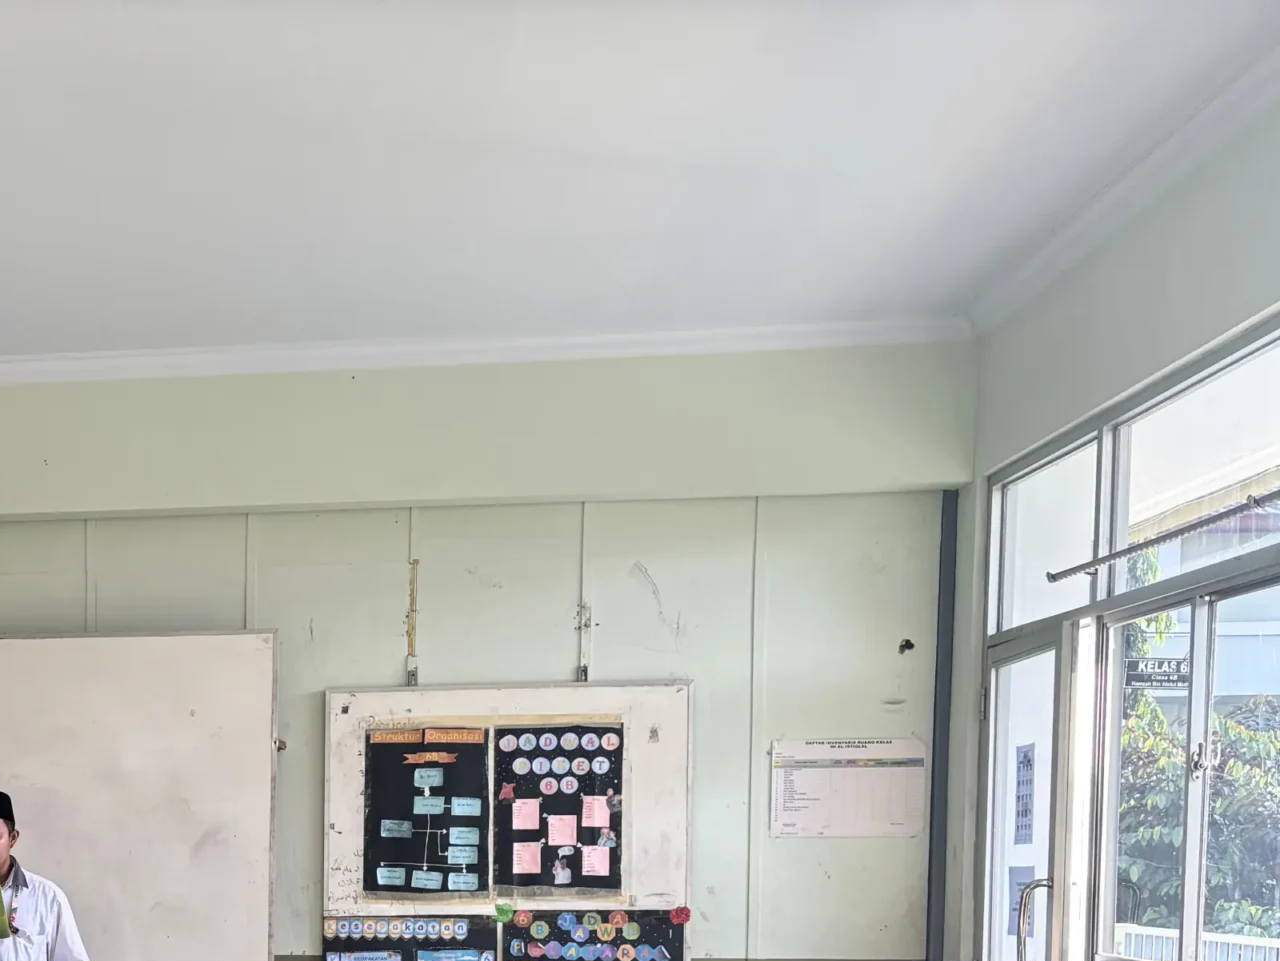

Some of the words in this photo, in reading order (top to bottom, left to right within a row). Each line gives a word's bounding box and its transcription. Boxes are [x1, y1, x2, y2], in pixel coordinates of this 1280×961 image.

[1137, 661, 1178, 673] KELAS
[1180, 661, 1190, 673] 6
[373, 731, 421, 742] Struktur
[426, 730, 483, 742] Organisasi
[425, 752, 439, 760] 6B
[542, 778, 577, 793] 6B
[325, 919, 466, 936] Kesepakatan
